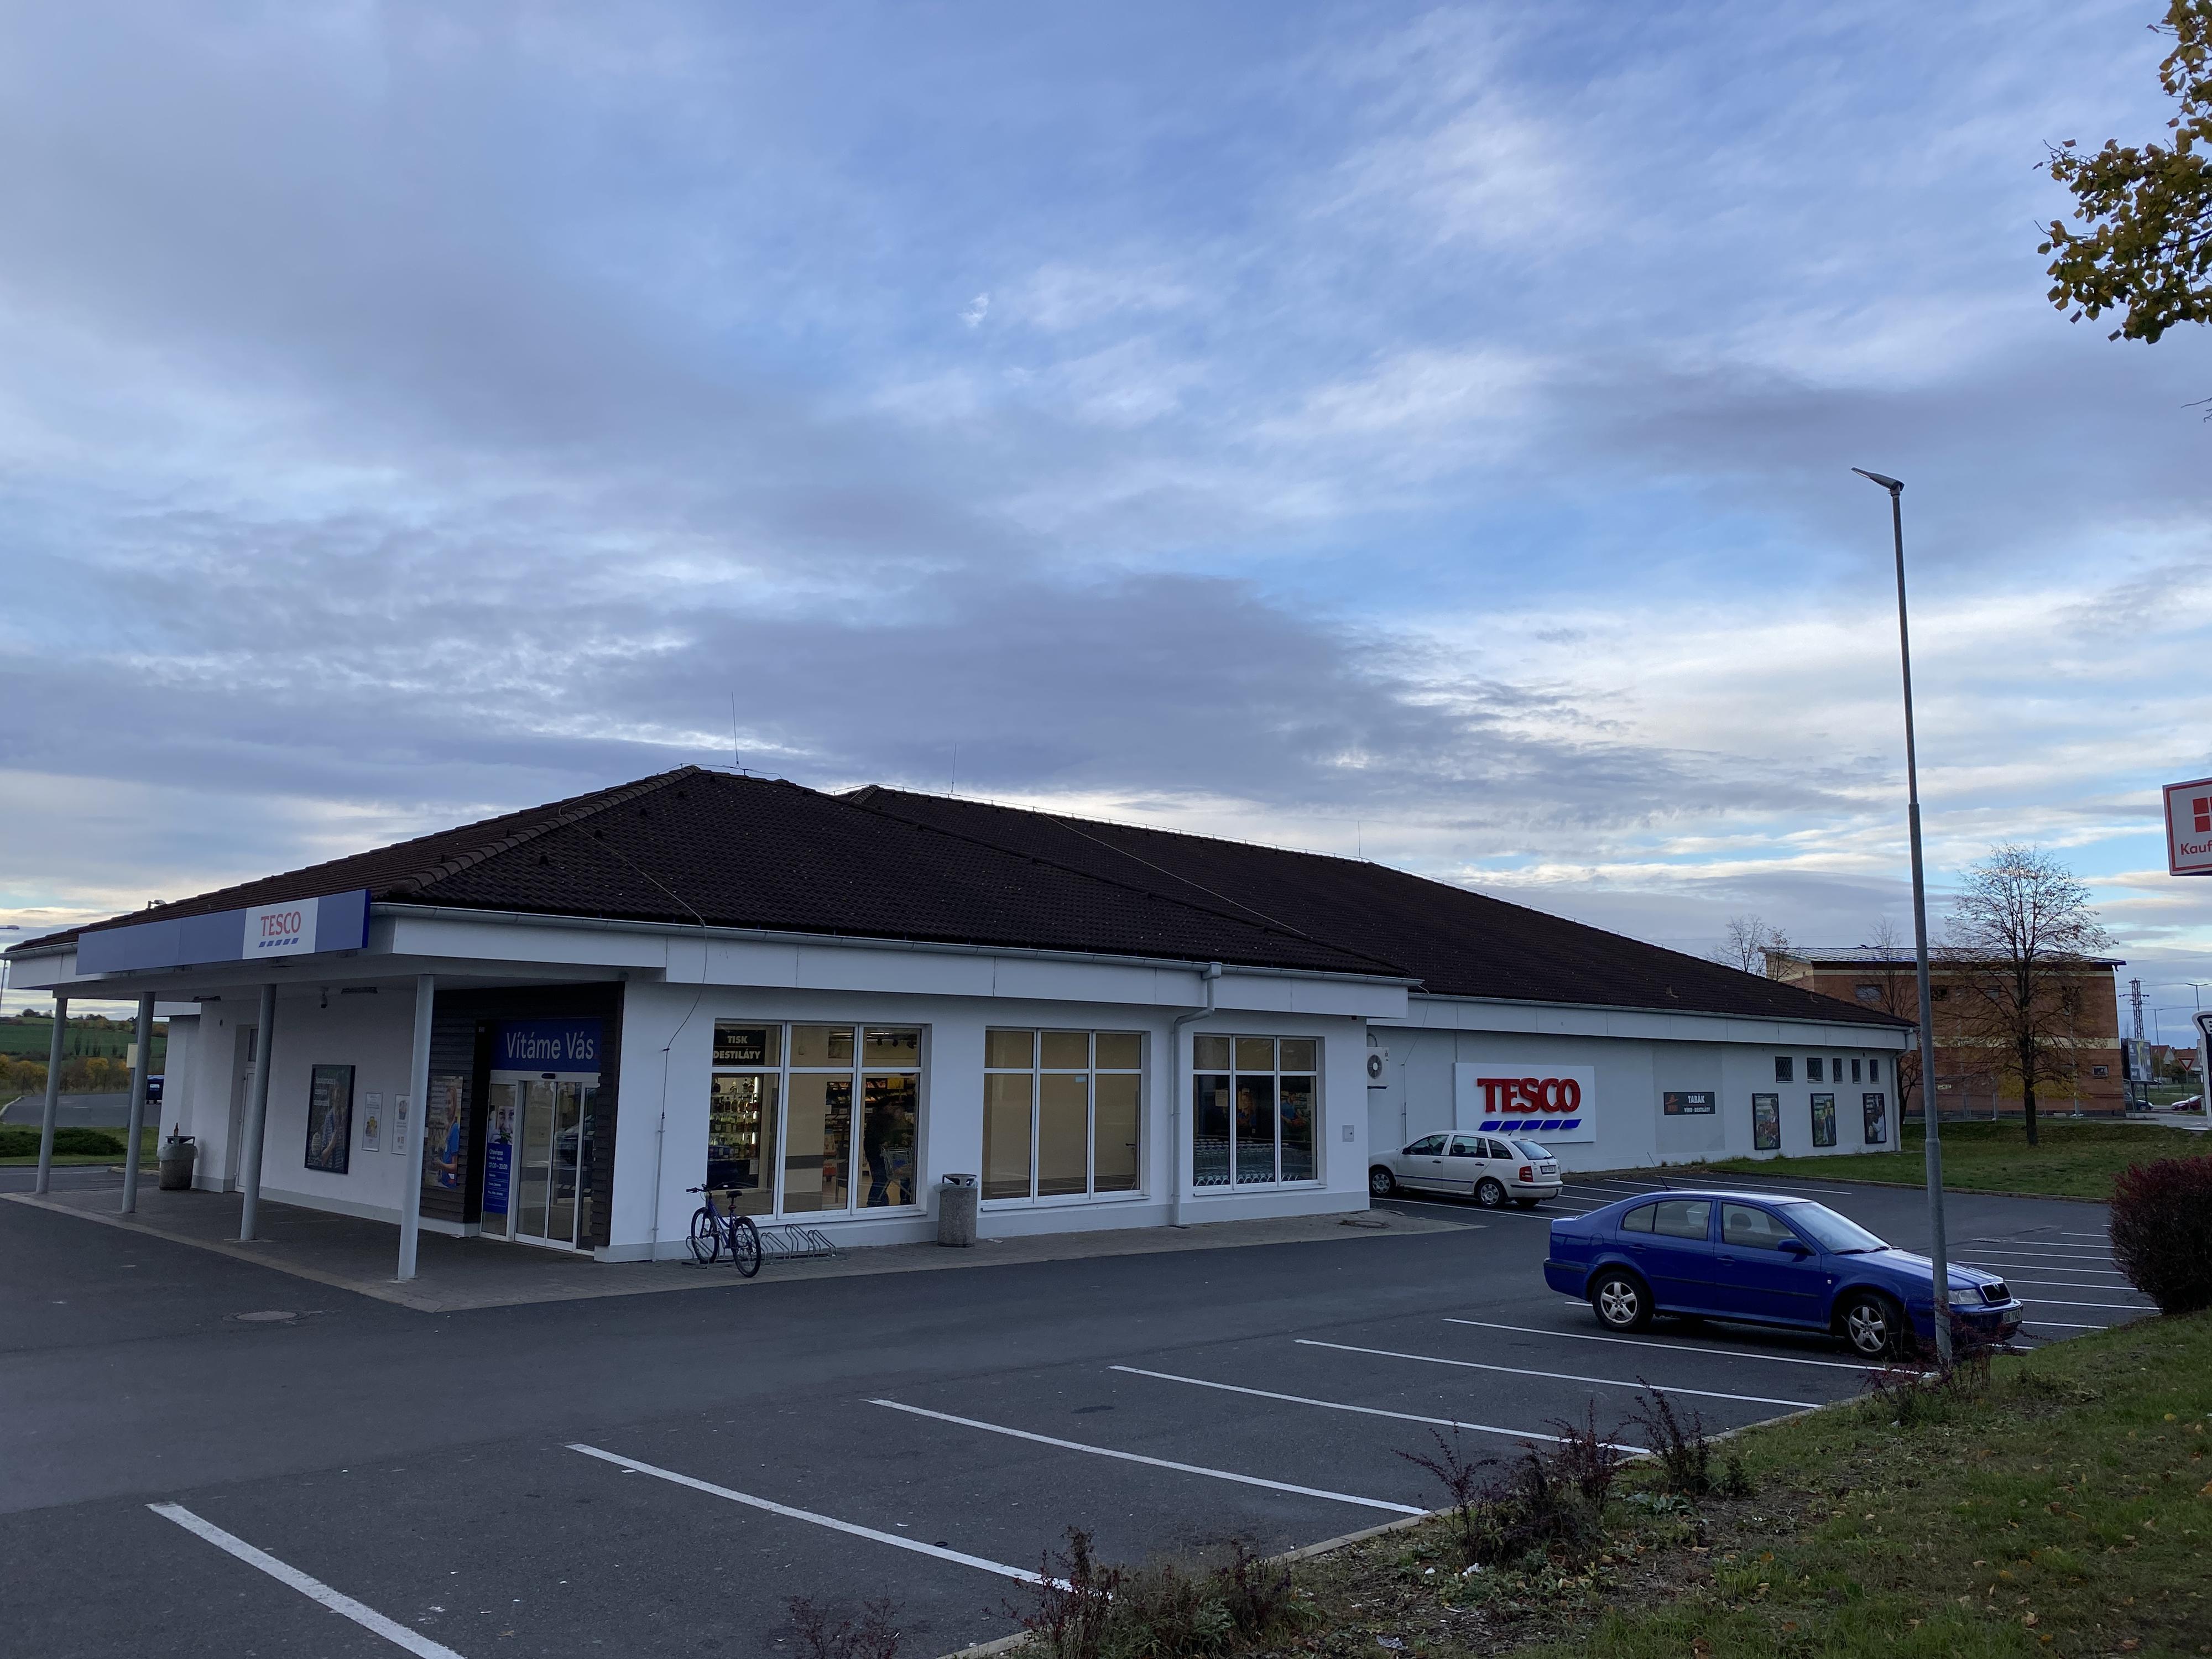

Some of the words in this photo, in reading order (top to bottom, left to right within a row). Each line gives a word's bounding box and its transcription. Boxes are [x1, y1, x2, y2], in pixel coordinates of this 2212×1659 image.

[2180, 839, 2212, 855] Kauf
[260, 911, 301, 936] TESCO
[506, 1031, 561, 1060] Vítáme
[566, 1031, 594, 1060] Vás
[727, 1035, 748, 1044] TISK
[713, 1048, 761, 1060] DESTILÁTY
[1477, 1077, 1581, 1113] TESCO
[1688, 1093, 1705, 1103] TABÁK
